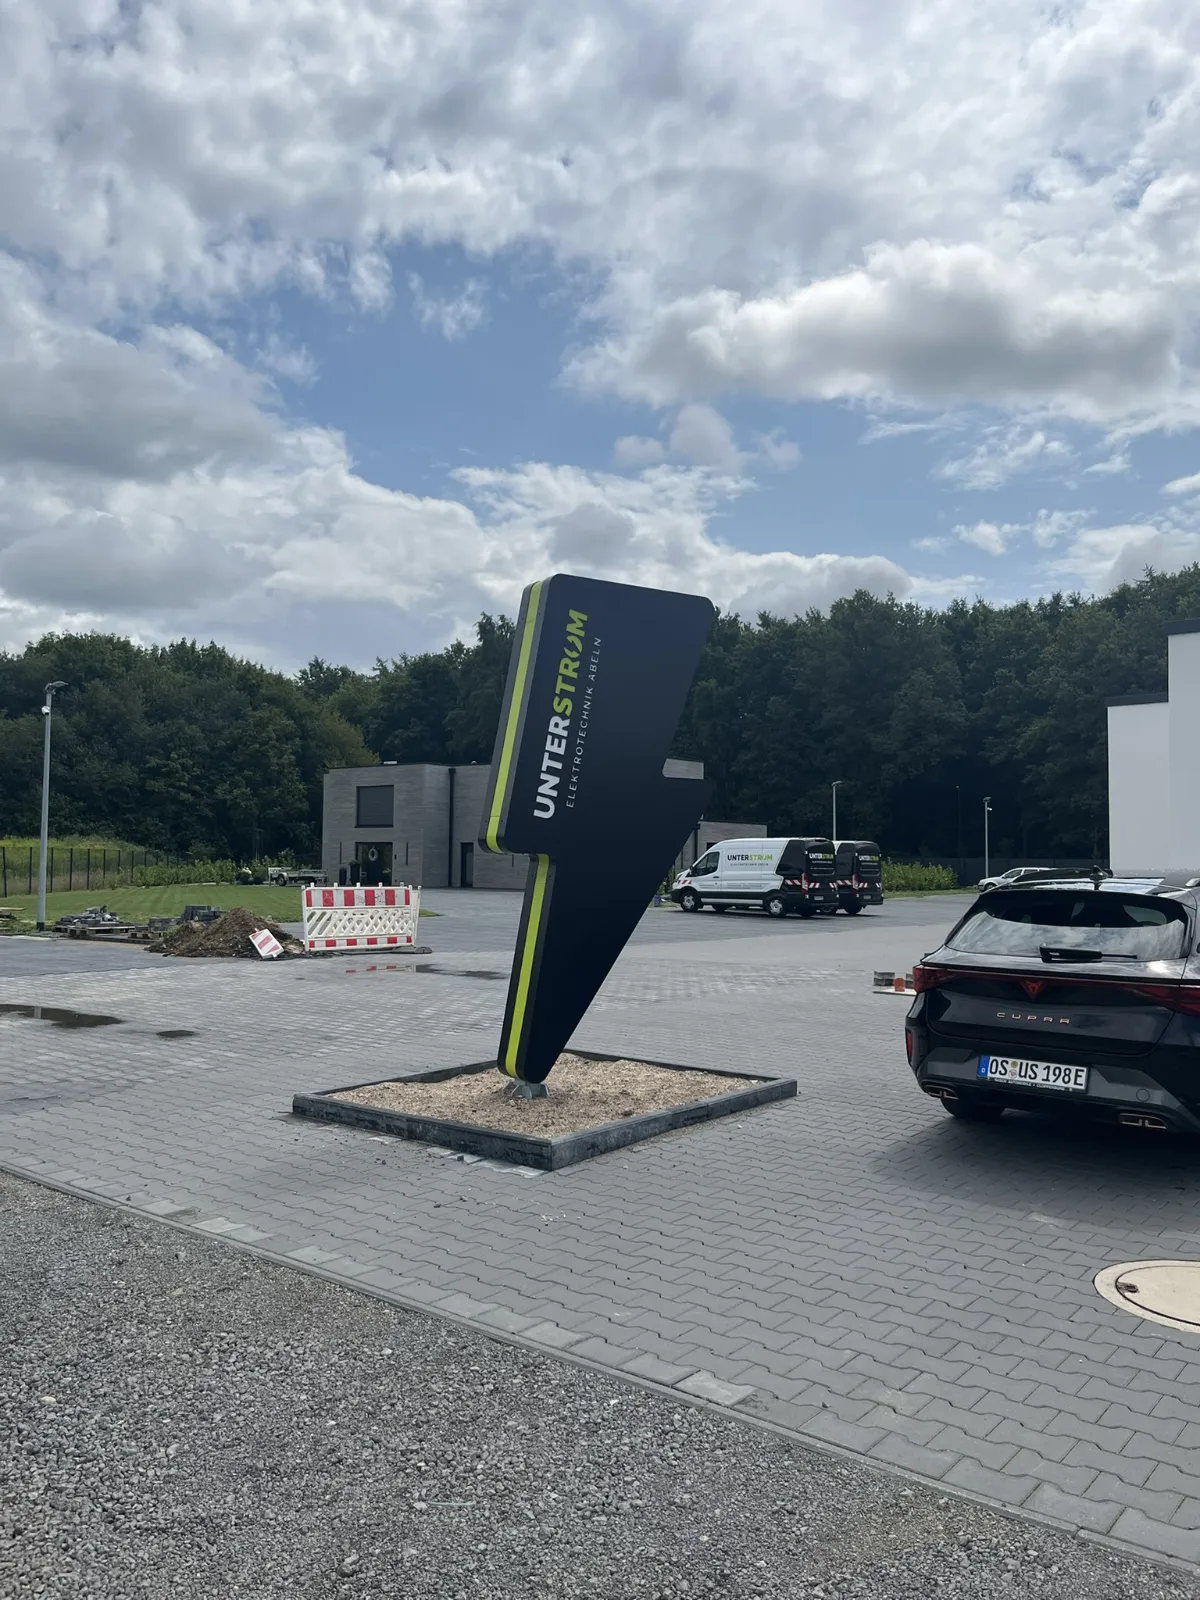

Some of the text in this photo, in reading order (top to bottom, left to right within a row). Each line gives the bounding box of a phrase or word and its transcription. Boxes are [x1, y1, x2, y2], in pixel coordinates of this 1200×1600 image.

[566, 637, 602, 808] ELEKTROTECHNIK ABELN
[996, 1012, 1070, 1024] CUPRA
[989, 1058, 1085, 1087] OS US 198E
